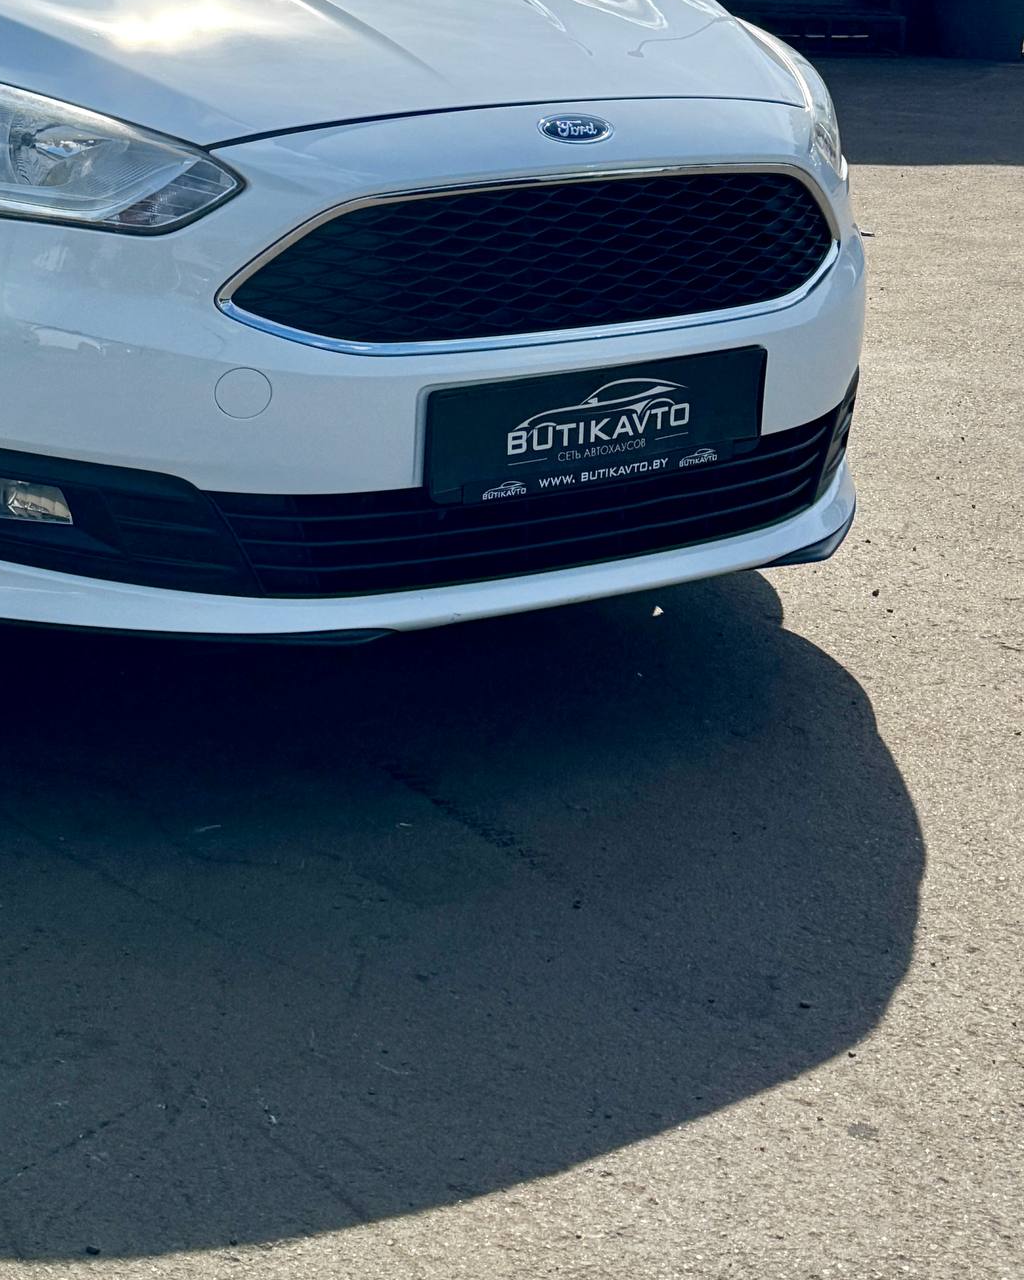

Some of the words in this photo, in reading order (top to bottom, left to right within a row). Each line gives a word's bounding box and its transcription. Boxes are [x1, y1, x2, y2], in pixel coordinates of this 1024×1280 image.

[556, 120, 597, 137] Ford
[507, 403, 690, 455] BUTIKAVTO
[557, 449, 582, 462] СЕТЬ
[583, 438, 647, 458] АВТОХАУСОВ
[539, 474, 575, 489] WWW.
[580, 457, 669, 482] BUTIKAVTO.BY
[482, 487, 527, 501] BUTIKAVTO
